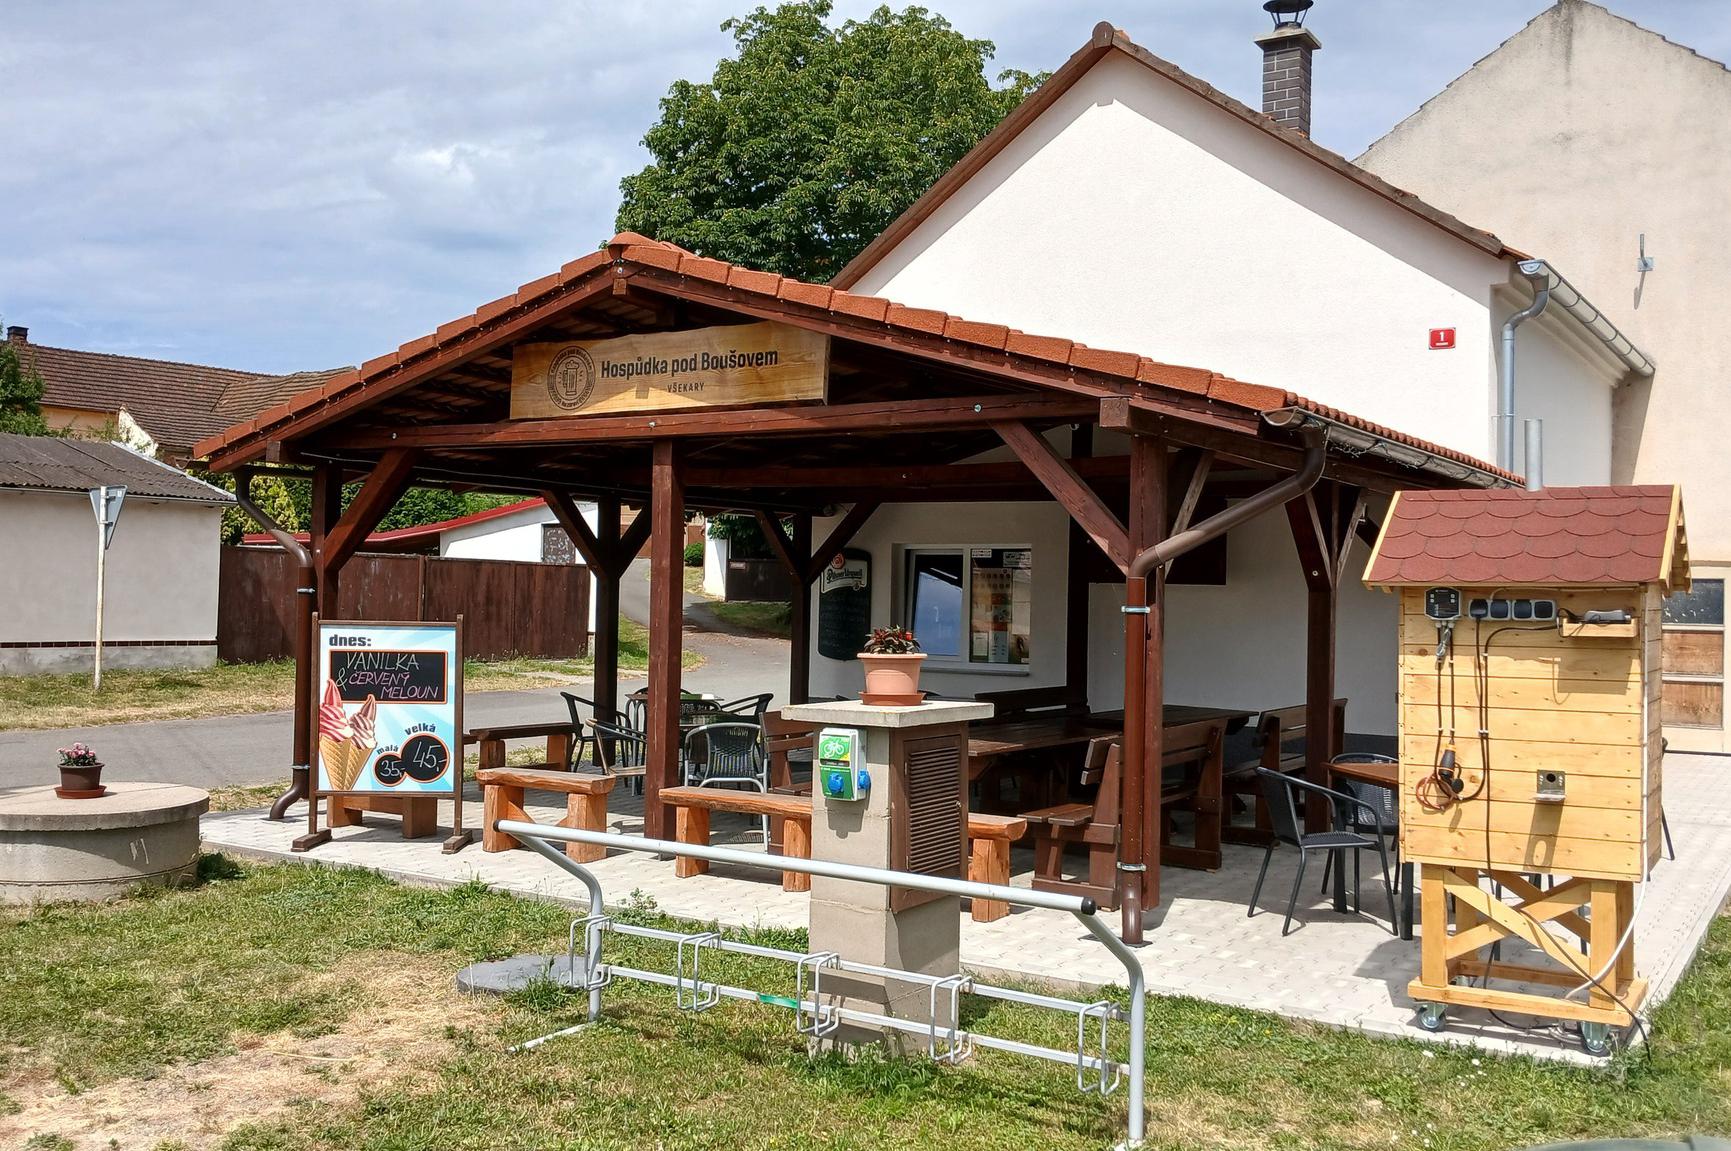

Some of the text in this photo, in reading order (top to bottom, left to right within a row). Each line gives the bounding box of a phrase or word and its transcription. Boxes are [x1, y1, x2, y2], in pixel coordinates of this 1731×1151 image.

[1440, 331, 1445, 342] 1
[601, 350, 778, 380] Hospůdka pod Boušovem
[667, 382, 705, 393] VŠEKARY
[329, 634, 372, 647] dnes:
[346, 651, 419, 671] VANILKA
[349, 669, 410, 685] ČERVENÝ
[380, 686, 438, 699] MELOUN
[404, 723, 436, 735] velká
[377, 744, 399, 754] malá
